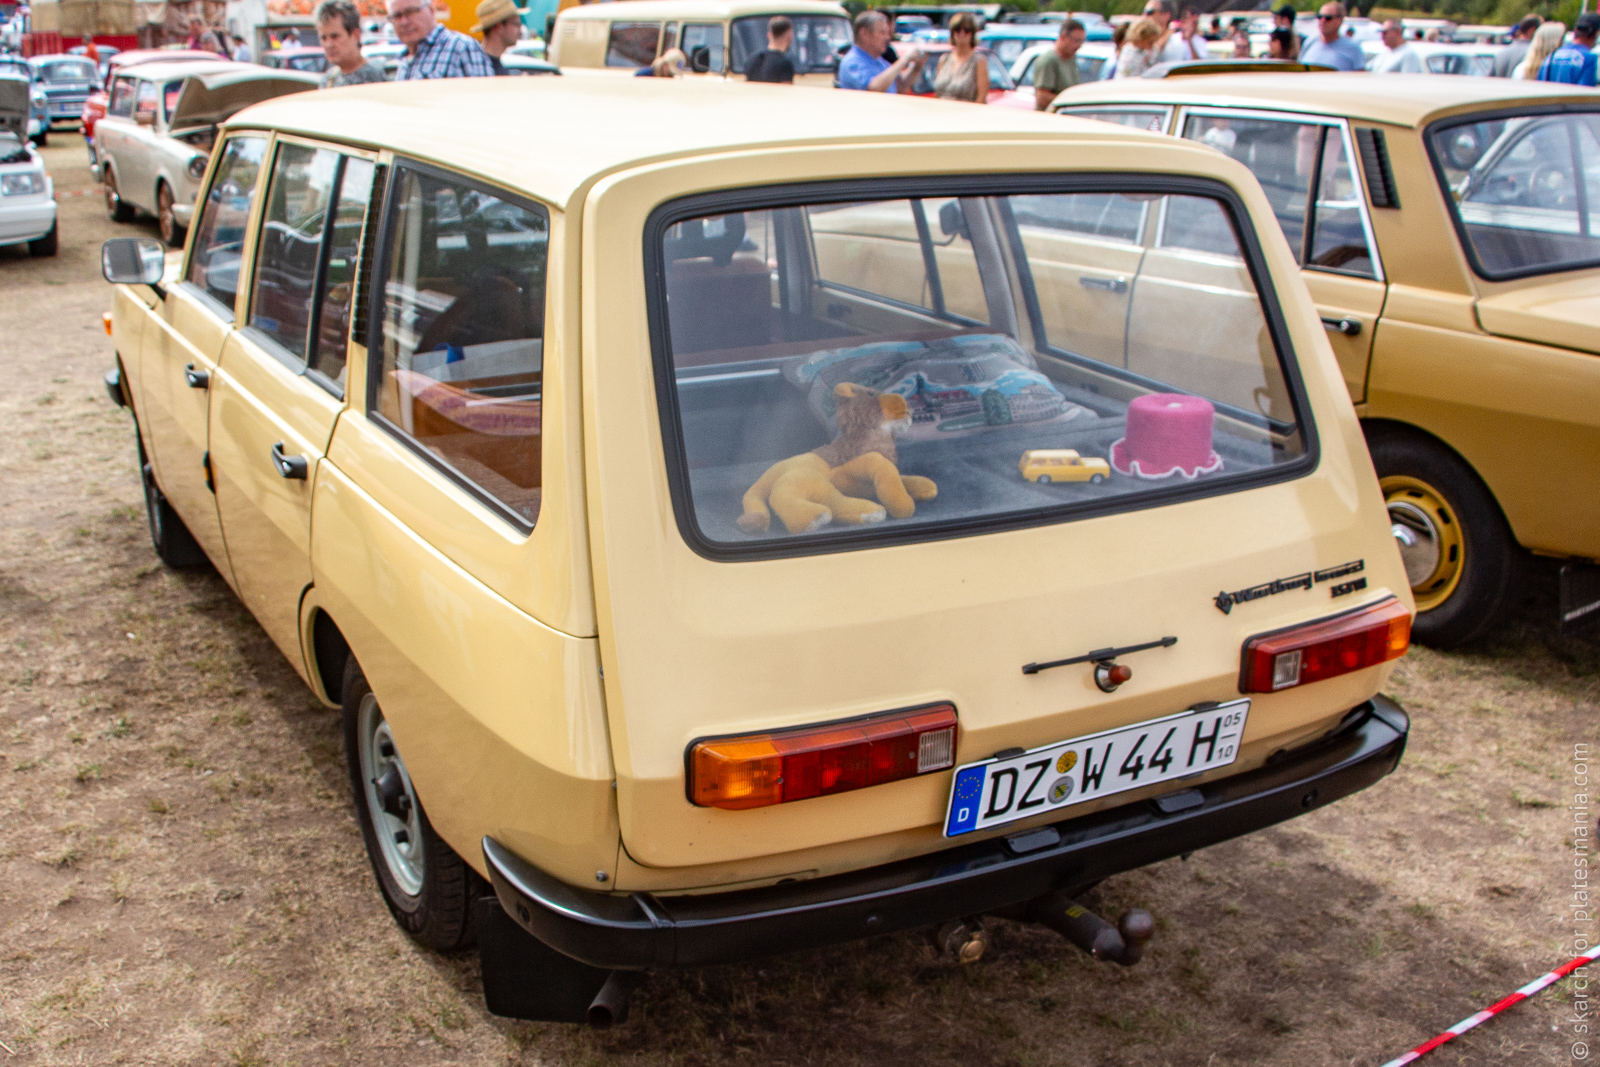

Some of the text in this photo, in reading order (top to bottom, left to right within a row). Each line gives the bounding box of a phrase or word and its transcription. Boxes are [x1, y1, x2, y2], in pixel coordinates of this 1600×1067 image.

[1223, 711, 1241, 728] 05
[1216, 745, 1233, 760] 10
[957, 716, 1222, 822] D DZ W 44 H
